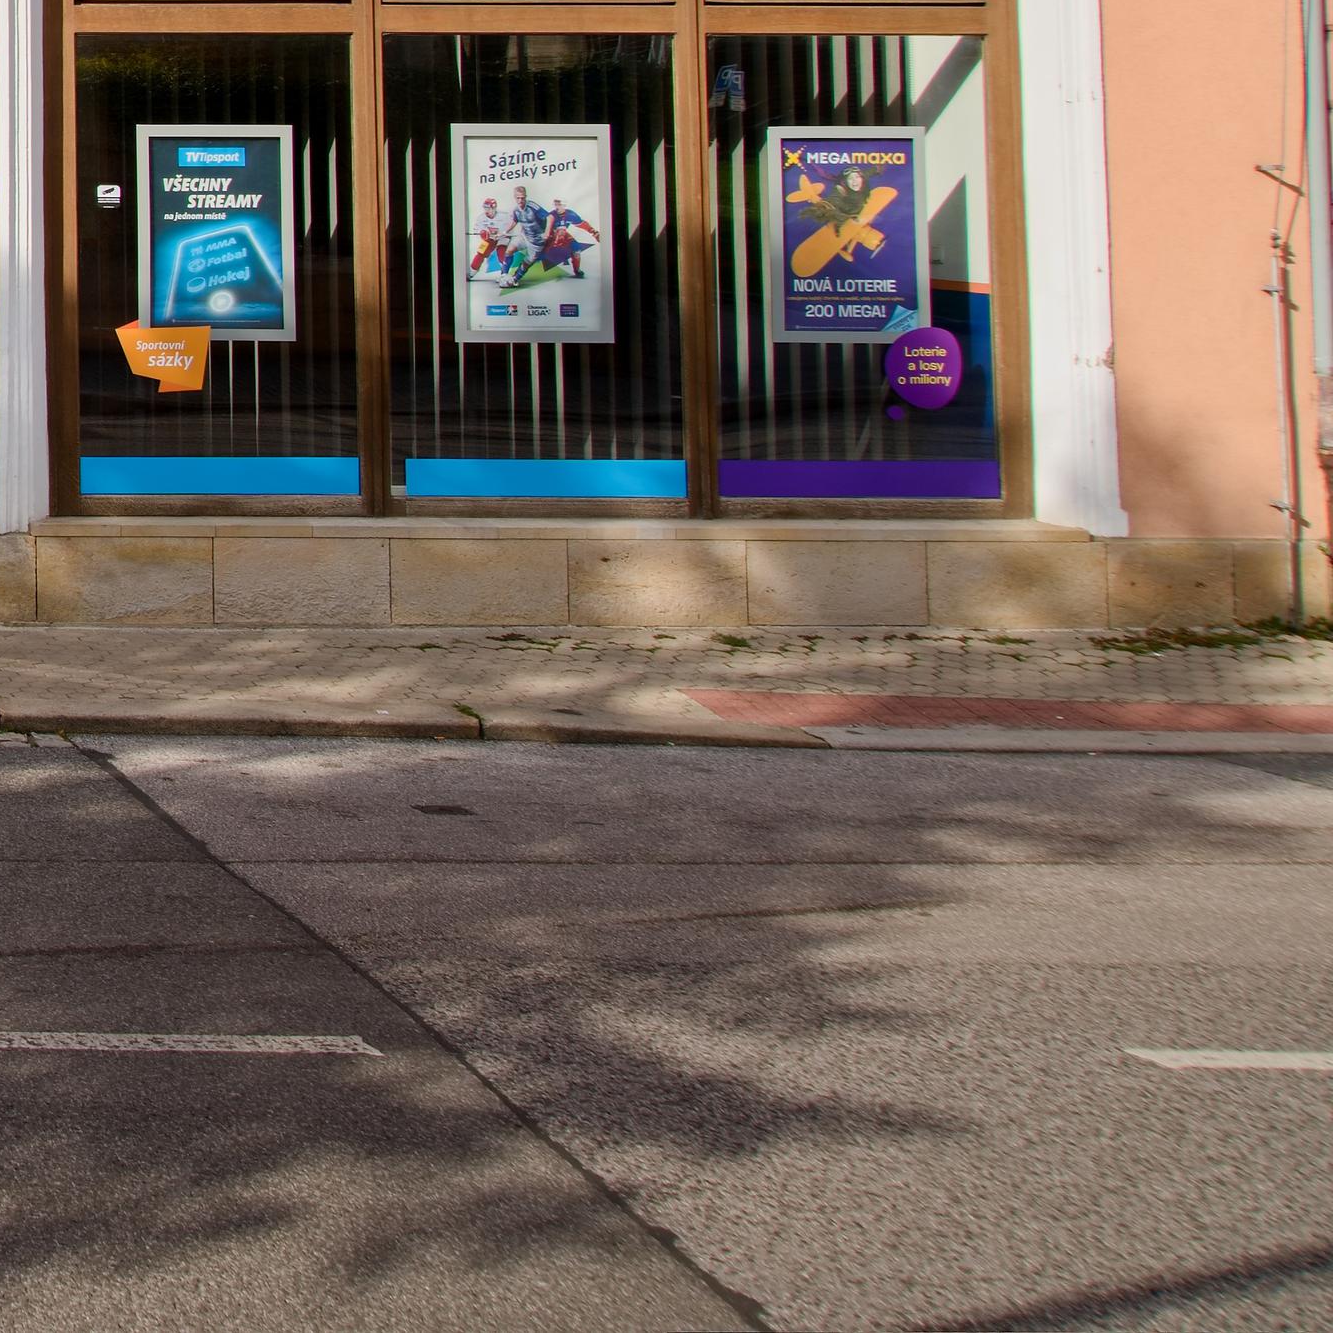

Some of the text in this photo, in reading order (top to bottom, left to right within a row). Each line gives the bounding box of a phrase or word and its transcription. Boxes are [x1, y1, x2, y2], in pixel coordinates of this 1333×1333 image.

[489, 149, 546, 169] Sázíme
[480, 159, 577, 184] na český sport
[162, 174, 232, 192] VŠECHNY
[187, 194, 263, 209] STREAMY
[174, 212, 203, 221] jednom
[204, 212, 226, 220] místě
[205, 237, 237, 253] MMA
[206, 248, 247, 267] Fotbal
[208, 266, 251, 287] Hokej
[793, 276, 898, 293] NOVÁ LOTERIE
[805, 304, 887, 318] 200 MEGA!
[136, 340, 185, 352] Sportovní
[904, 346, 947, 357] Loterie
[148, 352, 194, 370] sázky
[908, 361, 945, 372] a losy
[898, 374, 952, 386] o miliony
